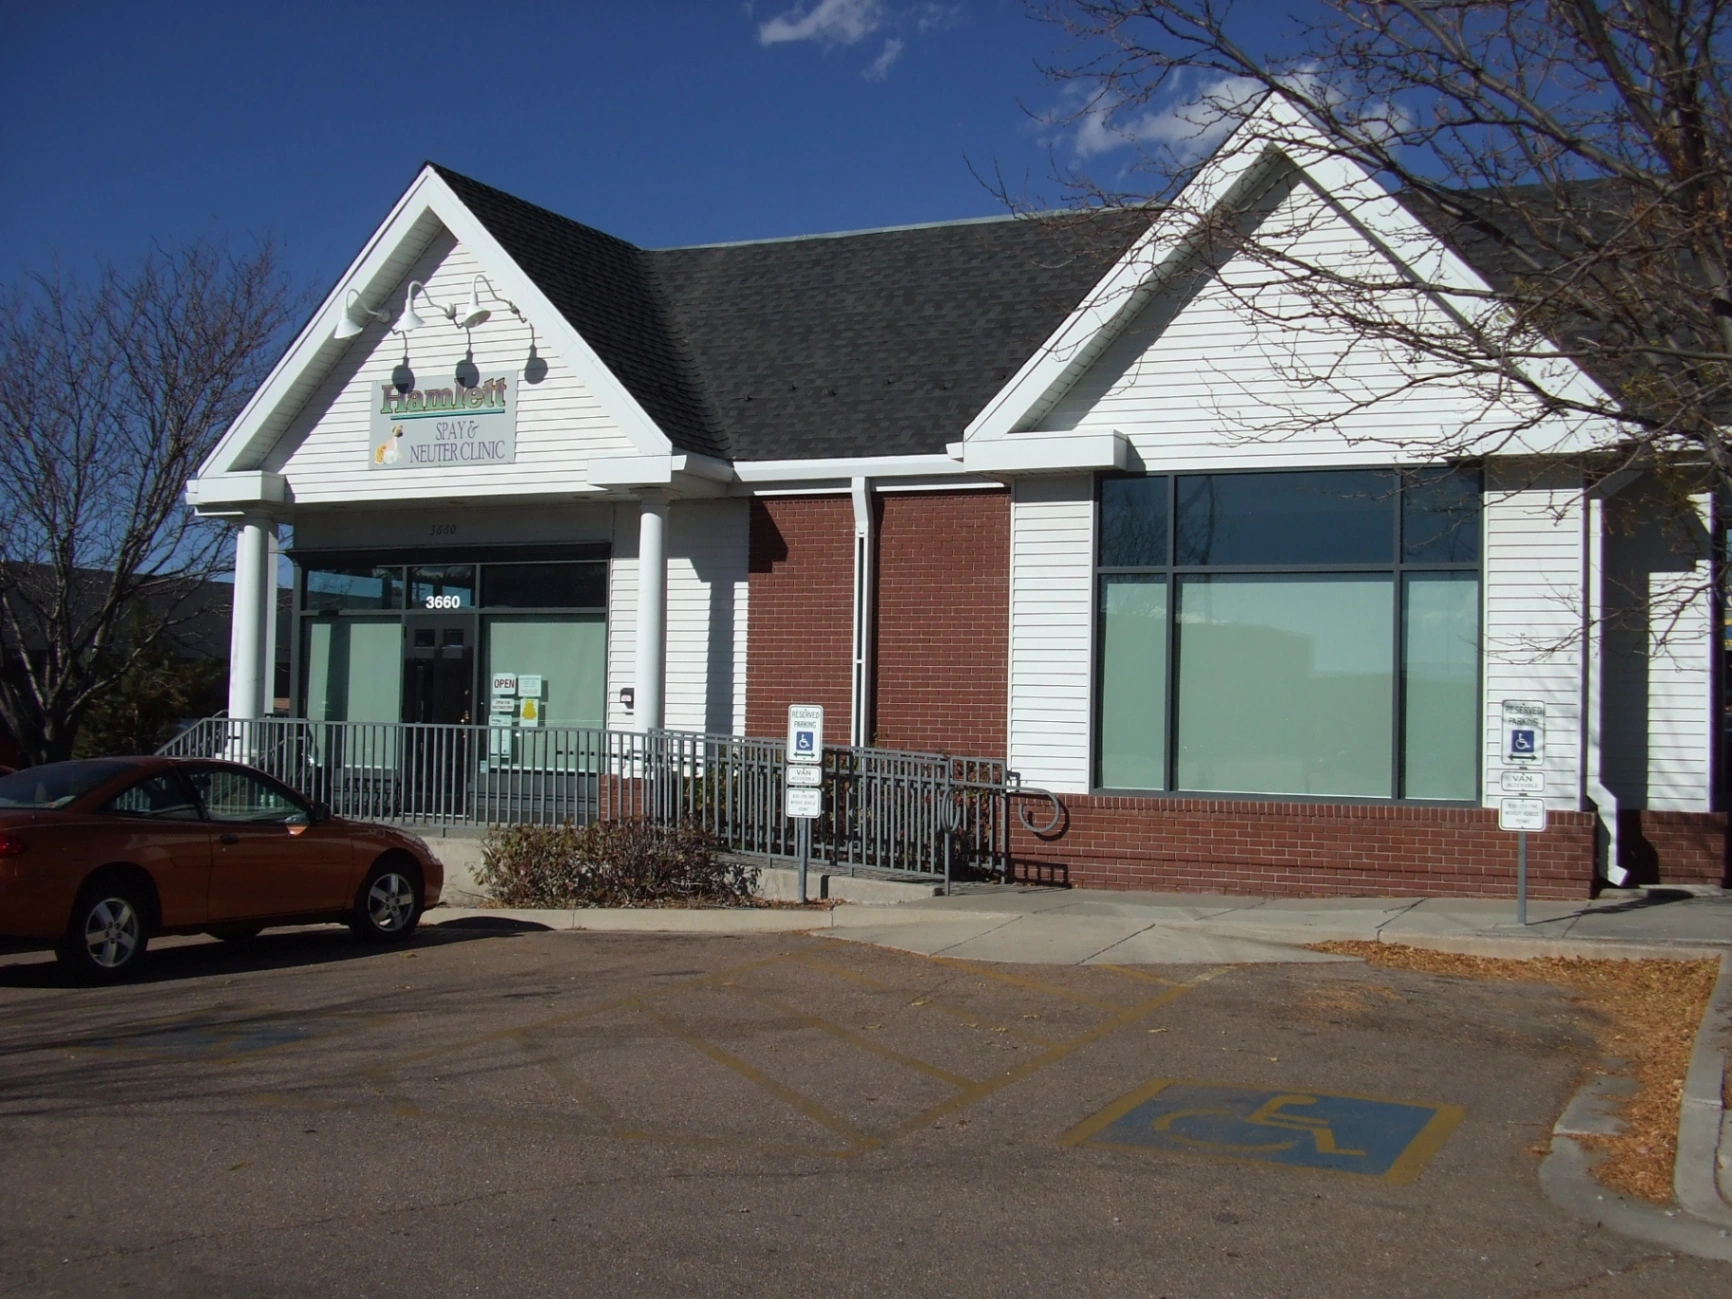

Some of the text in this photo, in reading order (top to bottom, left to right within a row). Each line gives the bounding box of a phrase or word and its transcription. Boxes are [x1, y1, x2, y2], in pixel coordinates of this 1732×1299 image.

[380, 377, 507, 414] Hamlett
[435, 420, 479, 441] SPAY &
[410, 440, 506, 463] NEUTER CLINIC
[429, 524, 457, 536] 3660
[425, 595, 461, 609] 3660
[494, 679, 515, 689] OPEN
[791, 710, 820, 719] RESERVED
[1505, 705, 1543, 715] RESERVED
[793, 720, 817, 729] PARKING
[1508, 717, 1539, 727] PARKING
[1512, 775, 1533, 783] VAN
